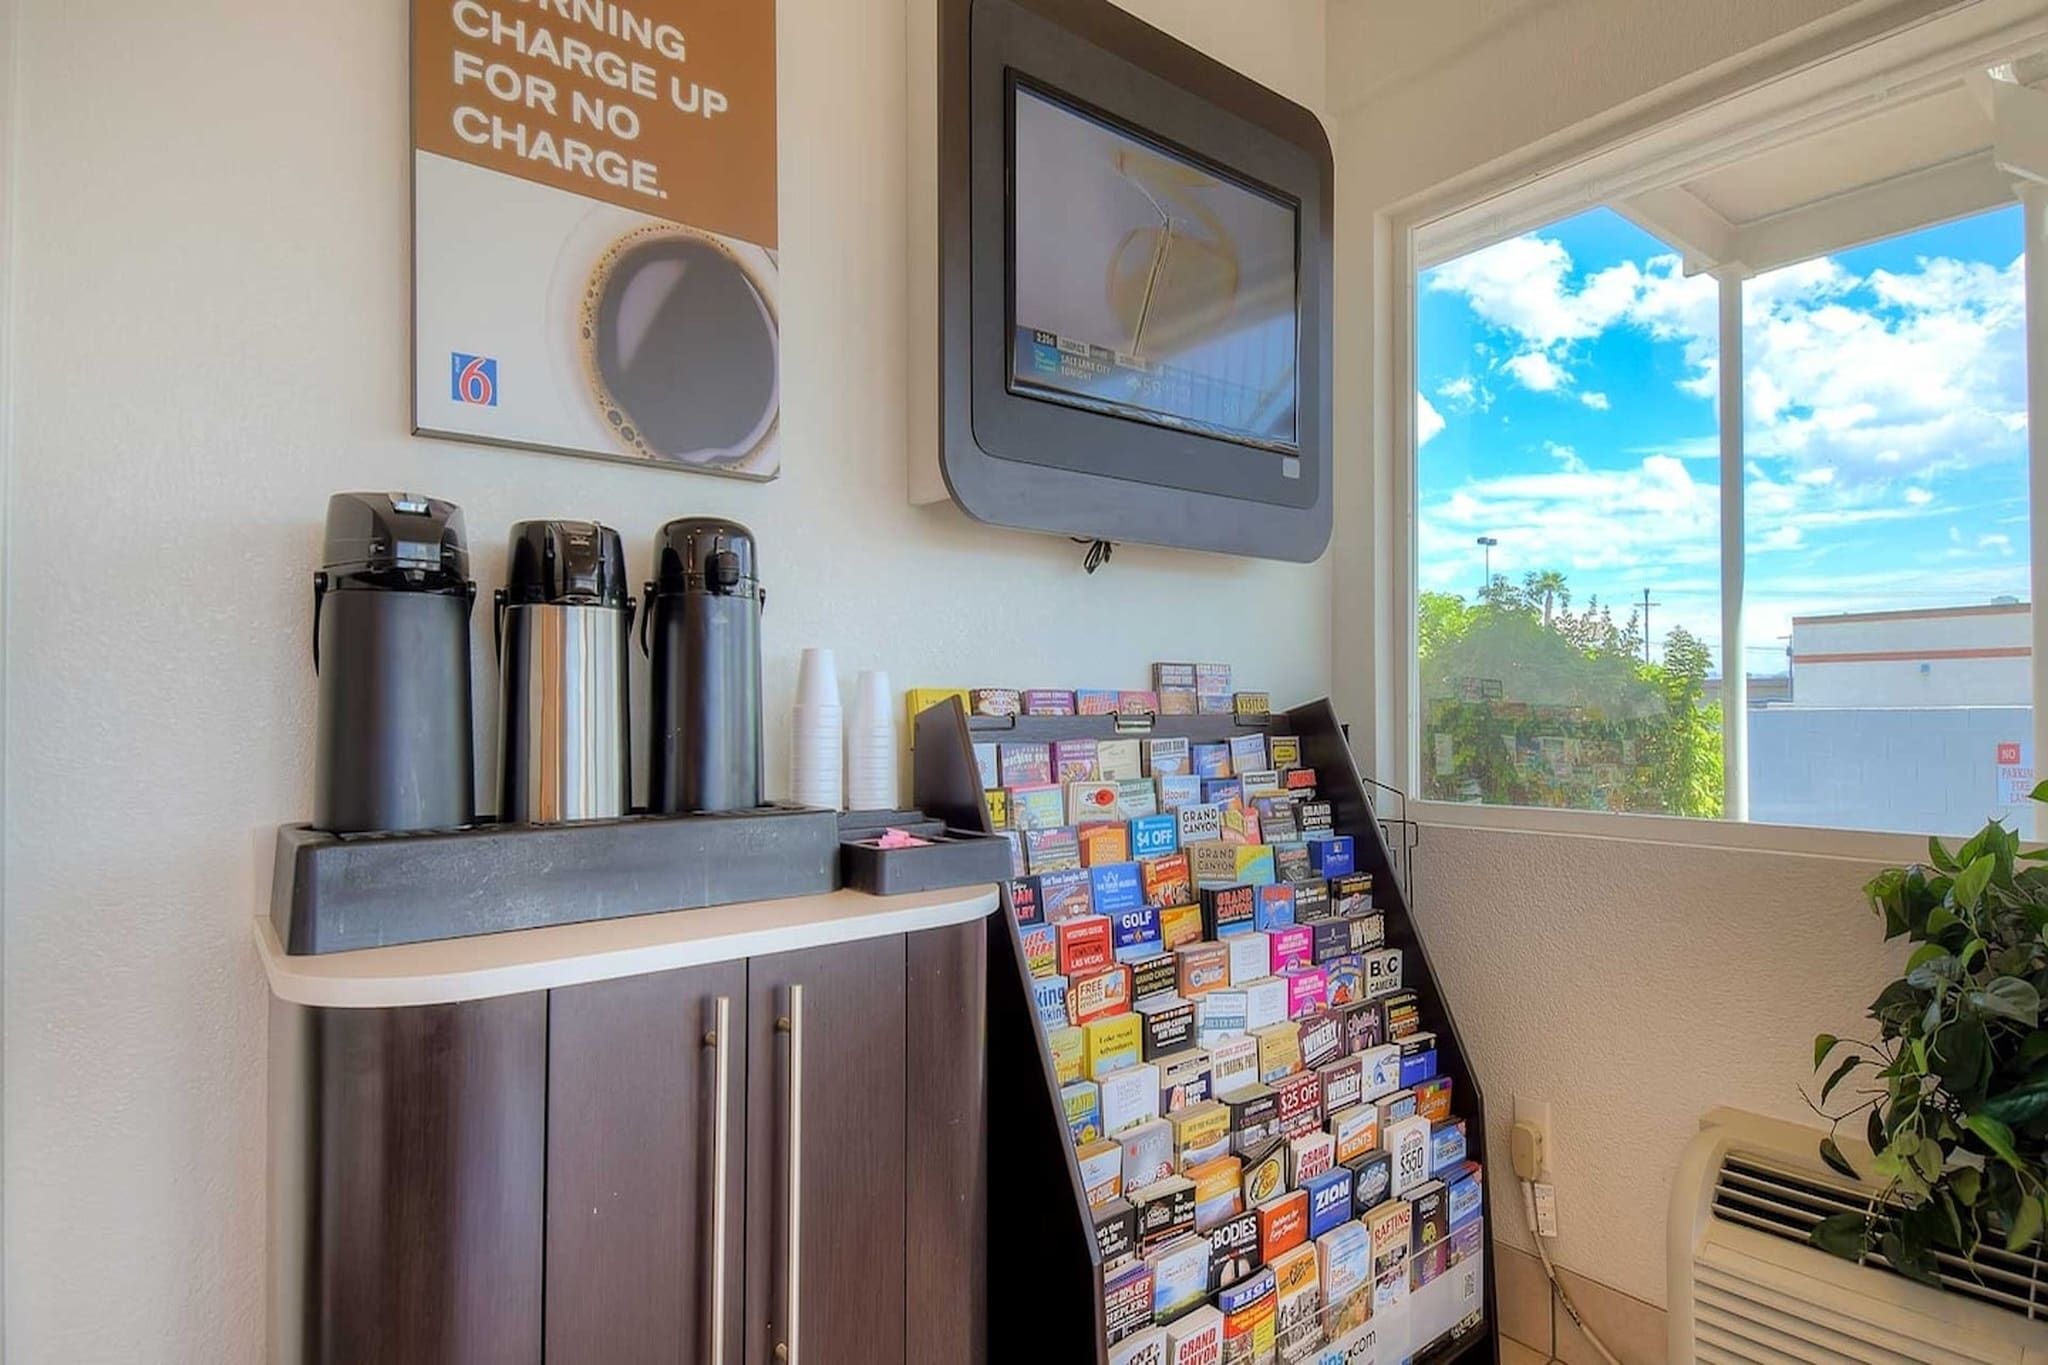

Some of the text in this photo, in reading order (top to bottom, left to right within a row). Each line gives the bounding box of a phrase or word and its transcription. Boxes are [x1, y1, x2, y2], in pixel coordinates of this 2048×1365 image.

[453, 0, 729, 119] CHARGE UP
[453, 50, 640, 140] FOR NO
[453, 106, 668, 199] CHARGE.
[459, 353, 492, 406] 6
[2002, 749, 2016, 760] NO
[1165, 788, 1190, 801] Hoover
[1183, 808, 1217, 822] GRAND
[1136, 829, 1172, 847] $4 OFF
[1183, 822, 1217, 834] CANYON
[1198, 848, 1234, 860] GRAND
[1198, 858, 1234, 871] CANYON
[1217, 885, 1252, 904] GRAND
[1217, 899, 1252, 917] CANYON
[1122, 911, 1151, 929] GOLF
[1080, 979, 1103, 995] FREE
[1370, 979, 1398, 993] CAMERA
[1281, 1091, 1299, 1112] $25
[1301, 1082, 1319, 1103] OFF
[1341, 1132, 1372, 1156] EVENTS
[1301, 1144, 1329, 1166] GRAND
[1400, 1147, 1424, 1176] $550
[1316, 1180, 1348, 1211] ZION
[1214, 1216, 1256, 1249] BODIES
[1374, 1209, 1410, 1242] RAFTING
[1180, 1328, 1216, 1360] GRAND
